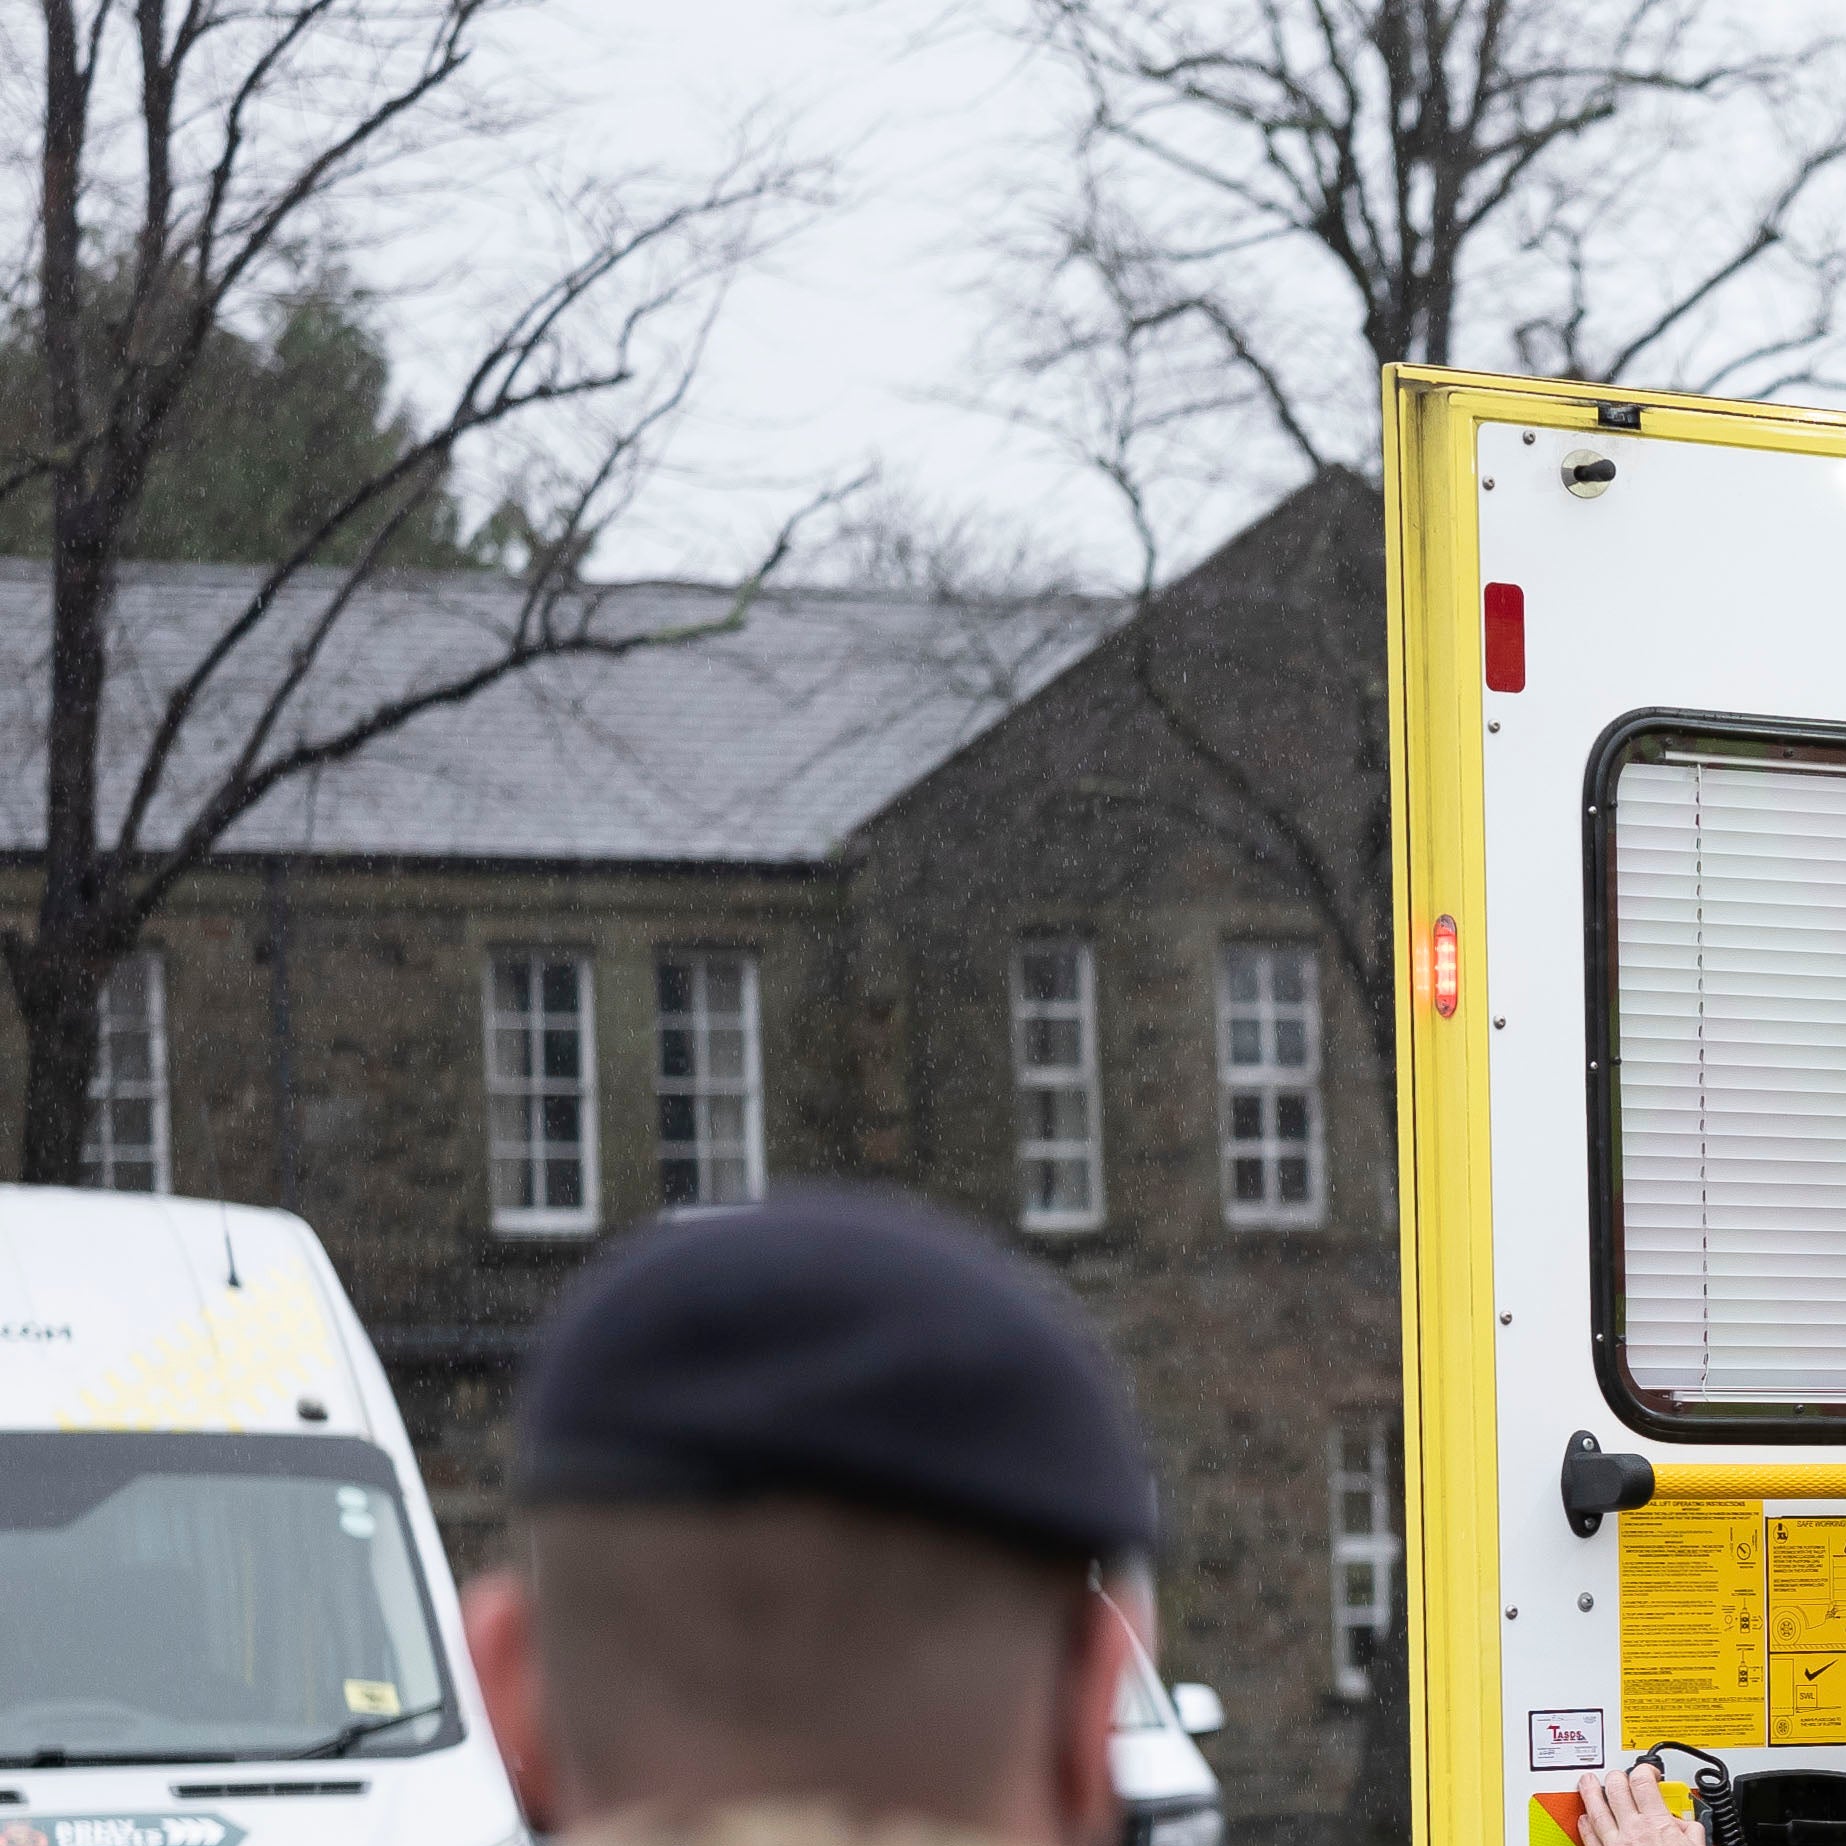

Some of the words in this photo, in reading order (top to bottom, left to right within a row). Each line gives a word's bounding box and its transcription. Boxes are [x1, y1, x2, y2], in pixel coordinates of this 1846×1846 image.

[1797, 1520, 1814, 1528] SAFE
[1815, 1520, 1846, 1528] WORKING
[1799, 1692, 1816, 1700] SWL
